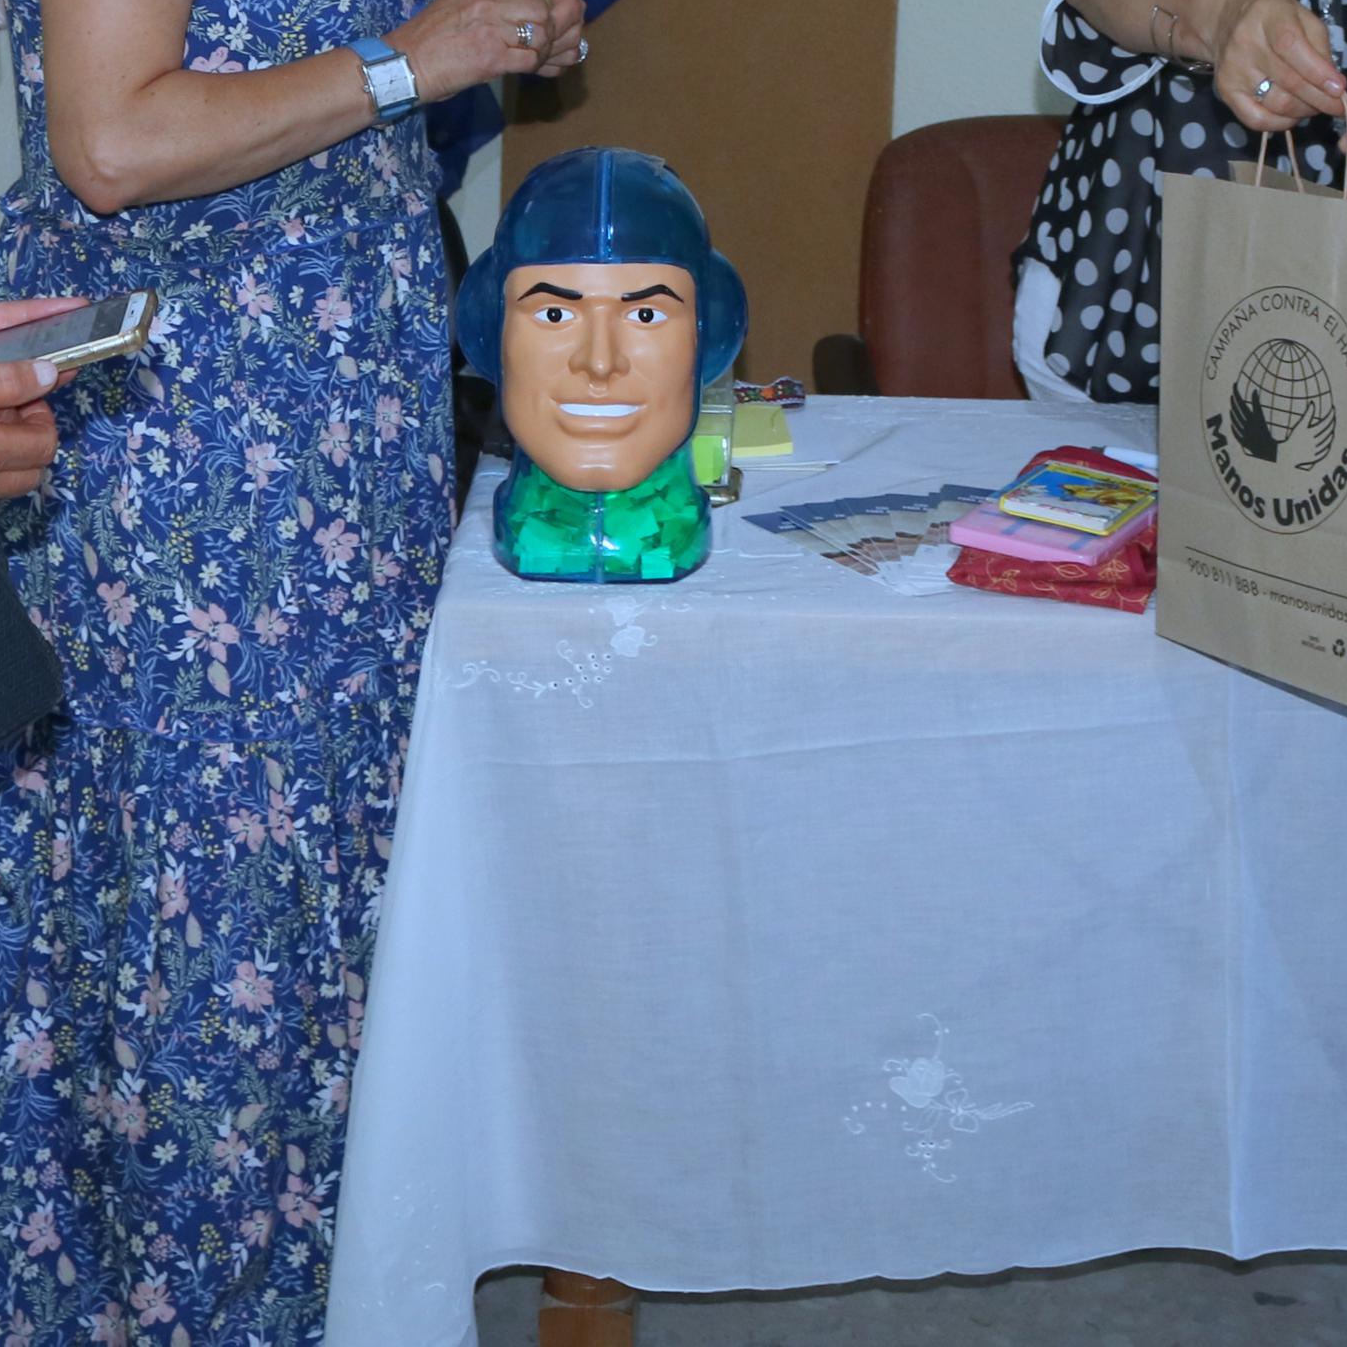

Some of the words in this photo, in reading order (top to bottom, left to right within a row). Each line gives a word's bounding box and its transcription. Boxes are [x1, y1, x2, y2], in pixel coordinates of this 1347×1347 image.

[1206, 304, 1257, 380] CAMPAÑA
[1261, 293, 1320, 323] CONTRA
[1323, 315, 1339, 337] EL
[1205, 413, 1266, 519] Manos
[1187, 557, 1210, 579] 900
[1212, 566, 1232, 587] 811
[1235, 576, 1259, 596] 888
